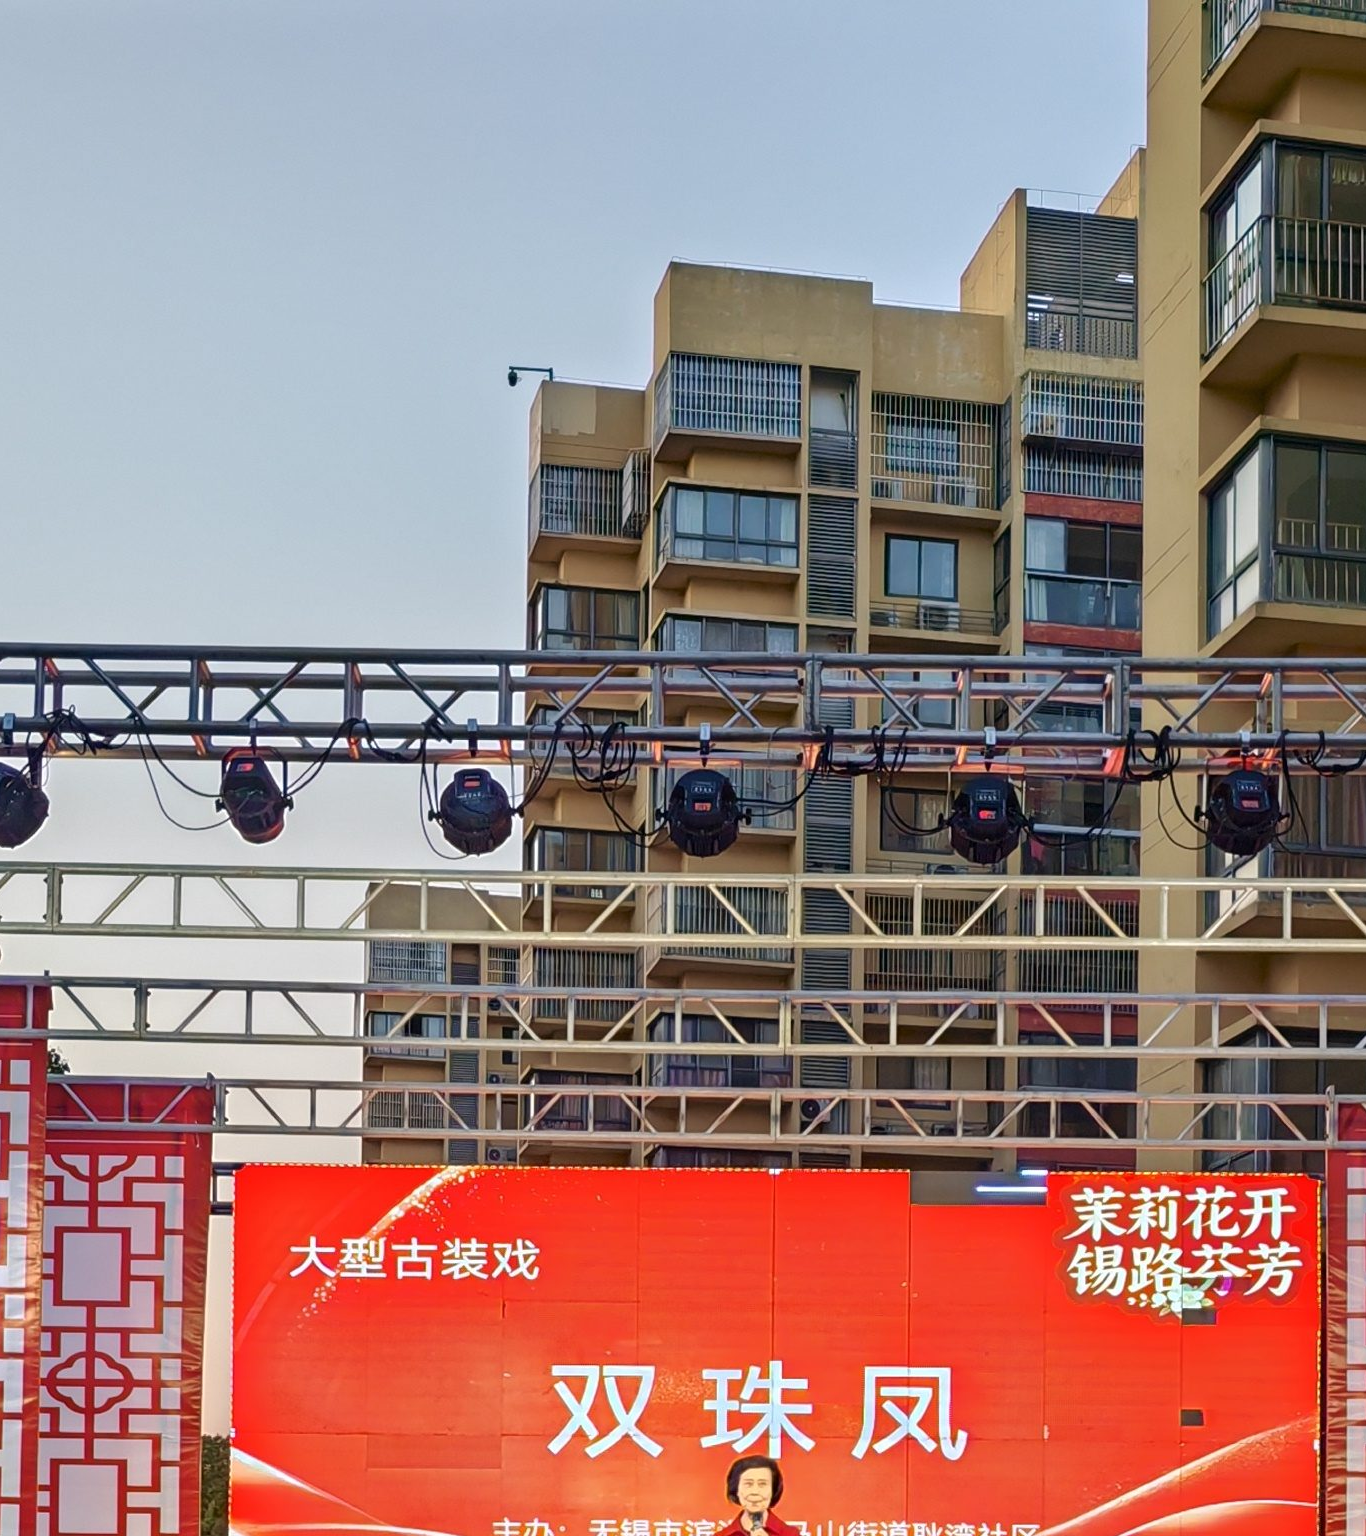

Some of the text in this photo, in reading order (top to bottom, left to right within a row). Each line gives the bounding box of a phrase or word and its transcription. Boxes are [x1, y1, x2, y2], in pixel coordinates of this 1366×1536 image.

[1063, 1185, 1297, 1242] 茉莉花开
[289, 1236, 540, 1280] 大型古装戏
[1066, 1241, 1303, 1297] 锡路芬芳
[547, 1360, 967, 1461] 双珠凤
